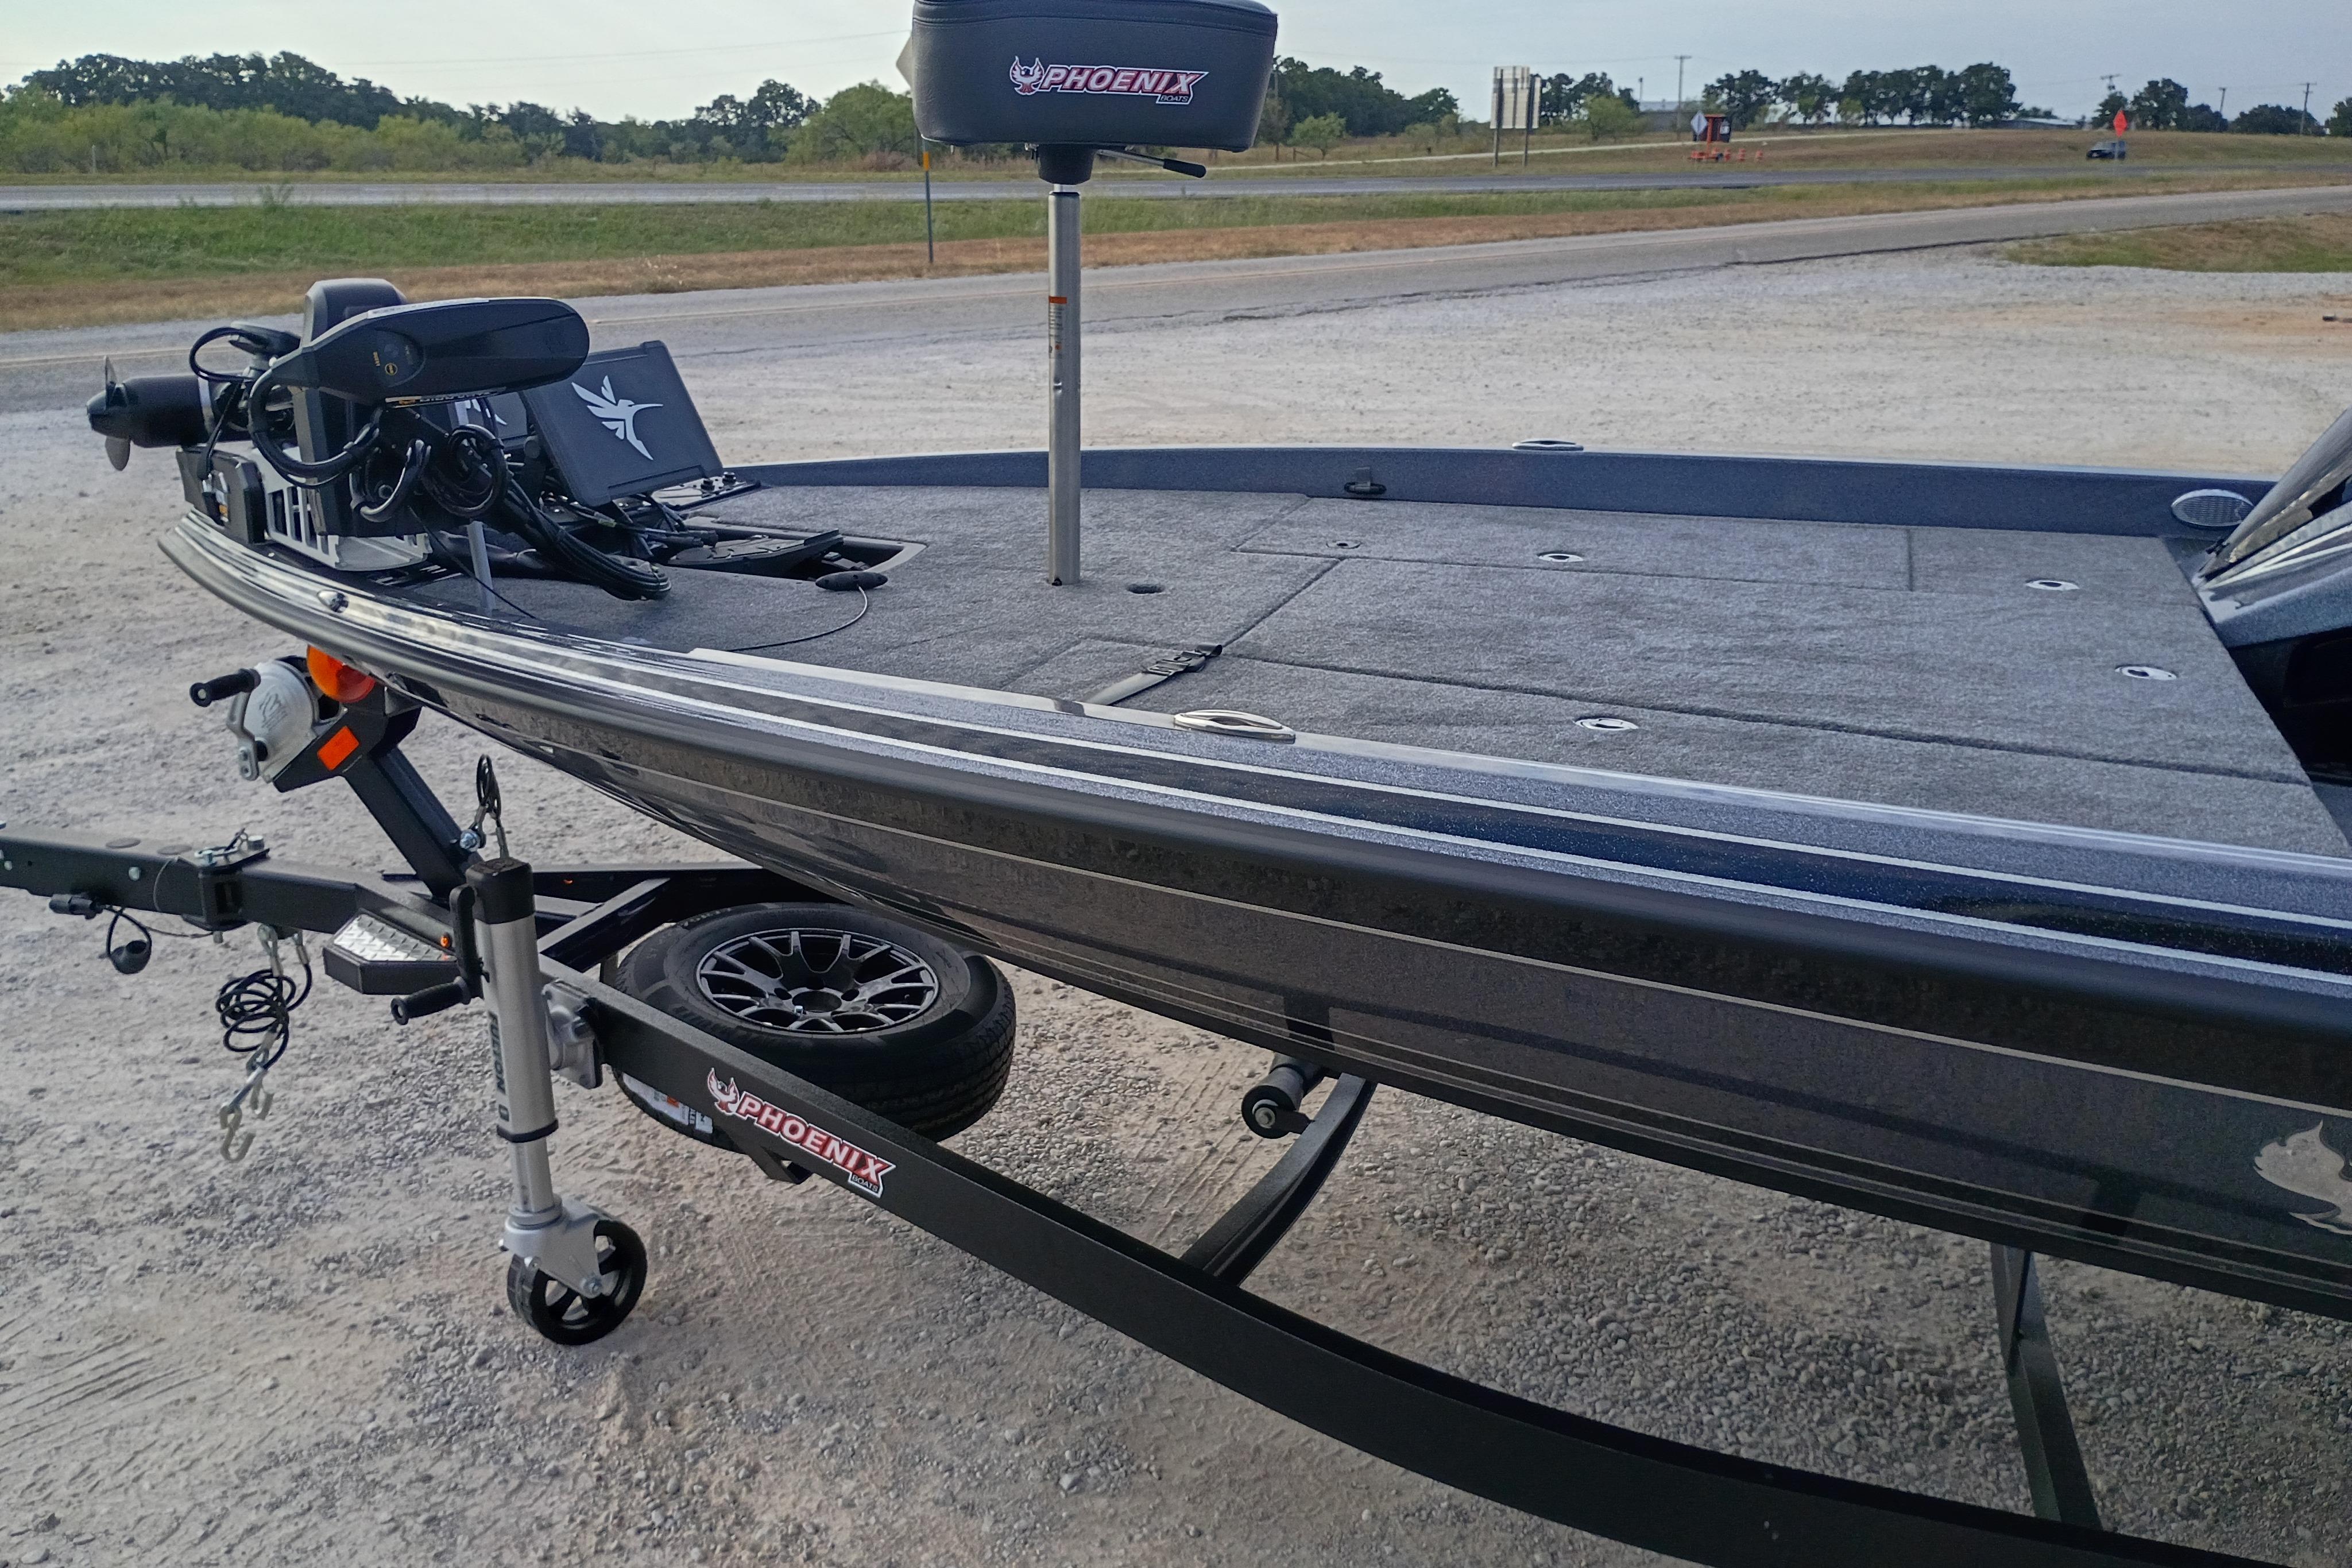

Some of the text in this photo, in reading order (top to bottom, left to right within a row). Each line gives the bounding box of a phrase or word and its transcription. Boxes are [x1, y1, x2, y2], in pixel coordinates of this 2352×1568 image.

[1041, 67, 1200, 94] PHOENIX
[488, 1011, 506, 1095] FULTON
[737, 1093, 891, 1183] PHOENIX
[852, 1175, 879, 1192] BOATS
